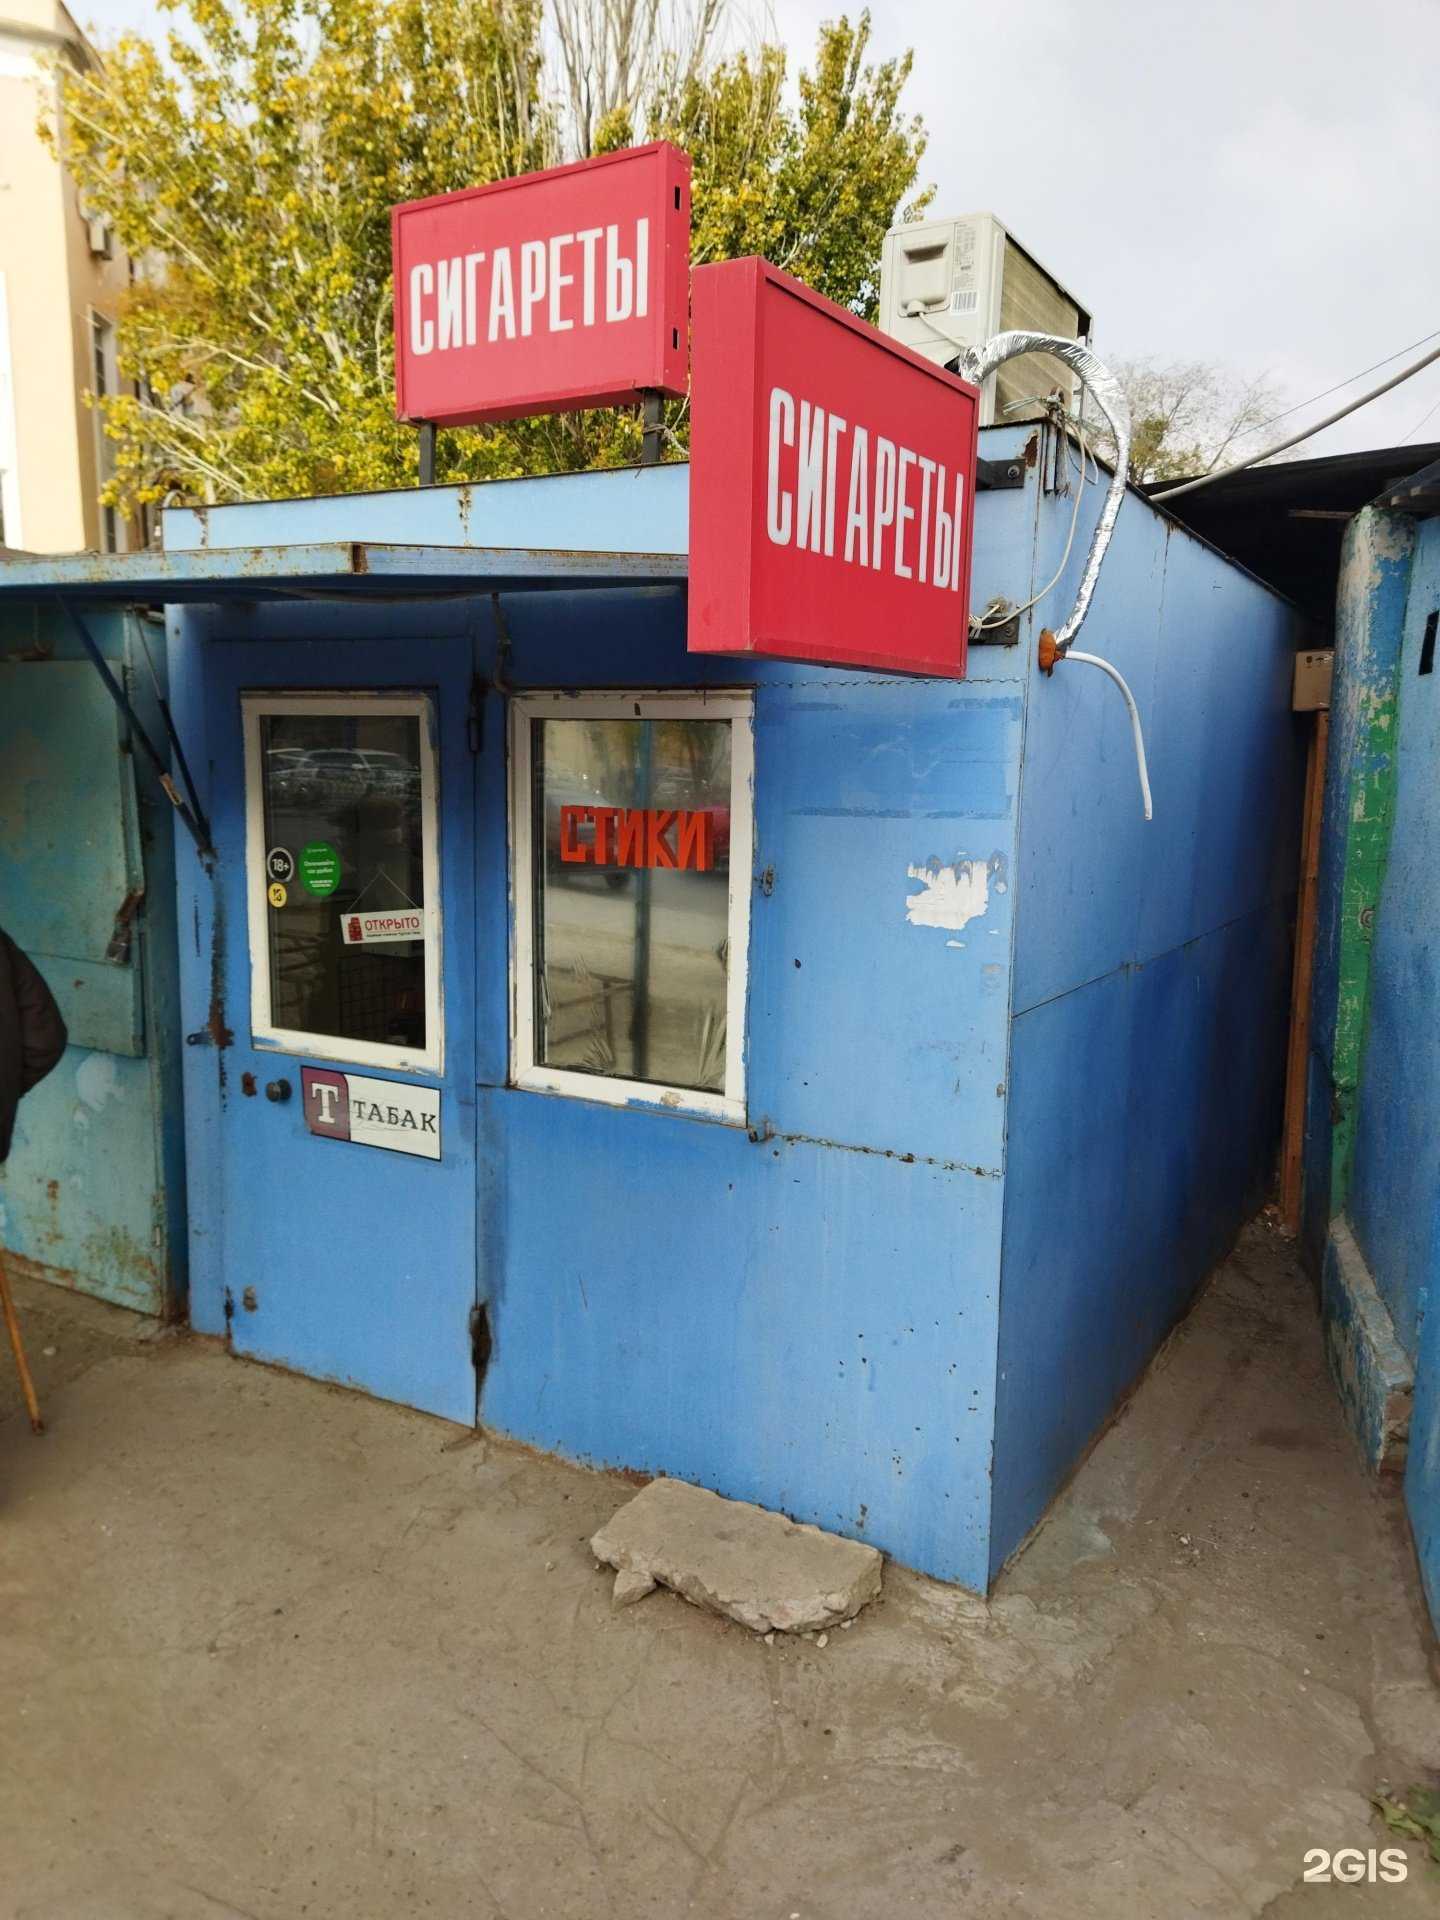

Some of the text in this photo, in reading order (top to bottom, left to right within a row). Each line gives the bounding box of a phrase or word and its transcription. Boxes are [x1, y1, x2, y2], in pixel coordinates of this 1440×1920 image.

[410, 218, 649, 356] СИГАРЕТЫ
[766, 386, 964, 592] СИГАРЕТЫ
[560, 805, 714, 871] СТИКИ
[272, 858, 289, 872] 18+
[364, 916, 420, 931] ОТКРЫТО
[353, 1100, 437, 1134] ТАБАК
